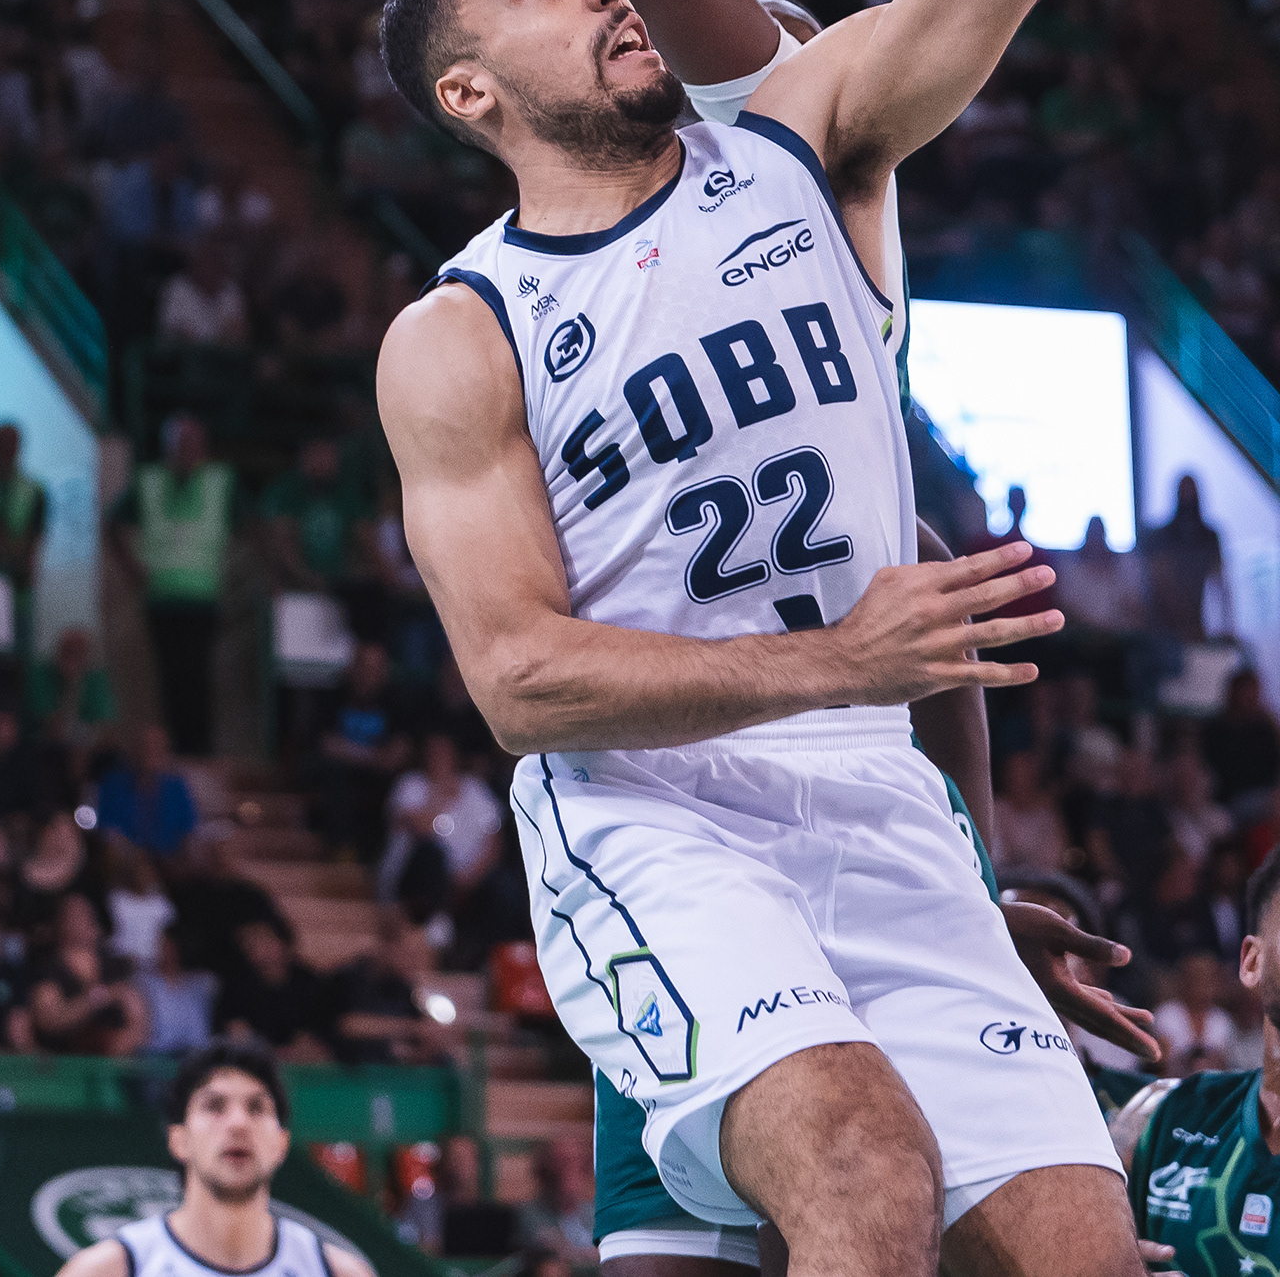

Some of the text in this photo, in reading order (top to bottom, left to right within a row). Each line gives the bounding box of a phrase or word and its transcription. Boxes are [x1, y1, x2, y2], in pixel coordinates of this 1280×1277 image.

[561, 301, 858, 511] SQBB
[665, 445, 853, 604] 22
[1030, 1029, 1077, 1056] tran
